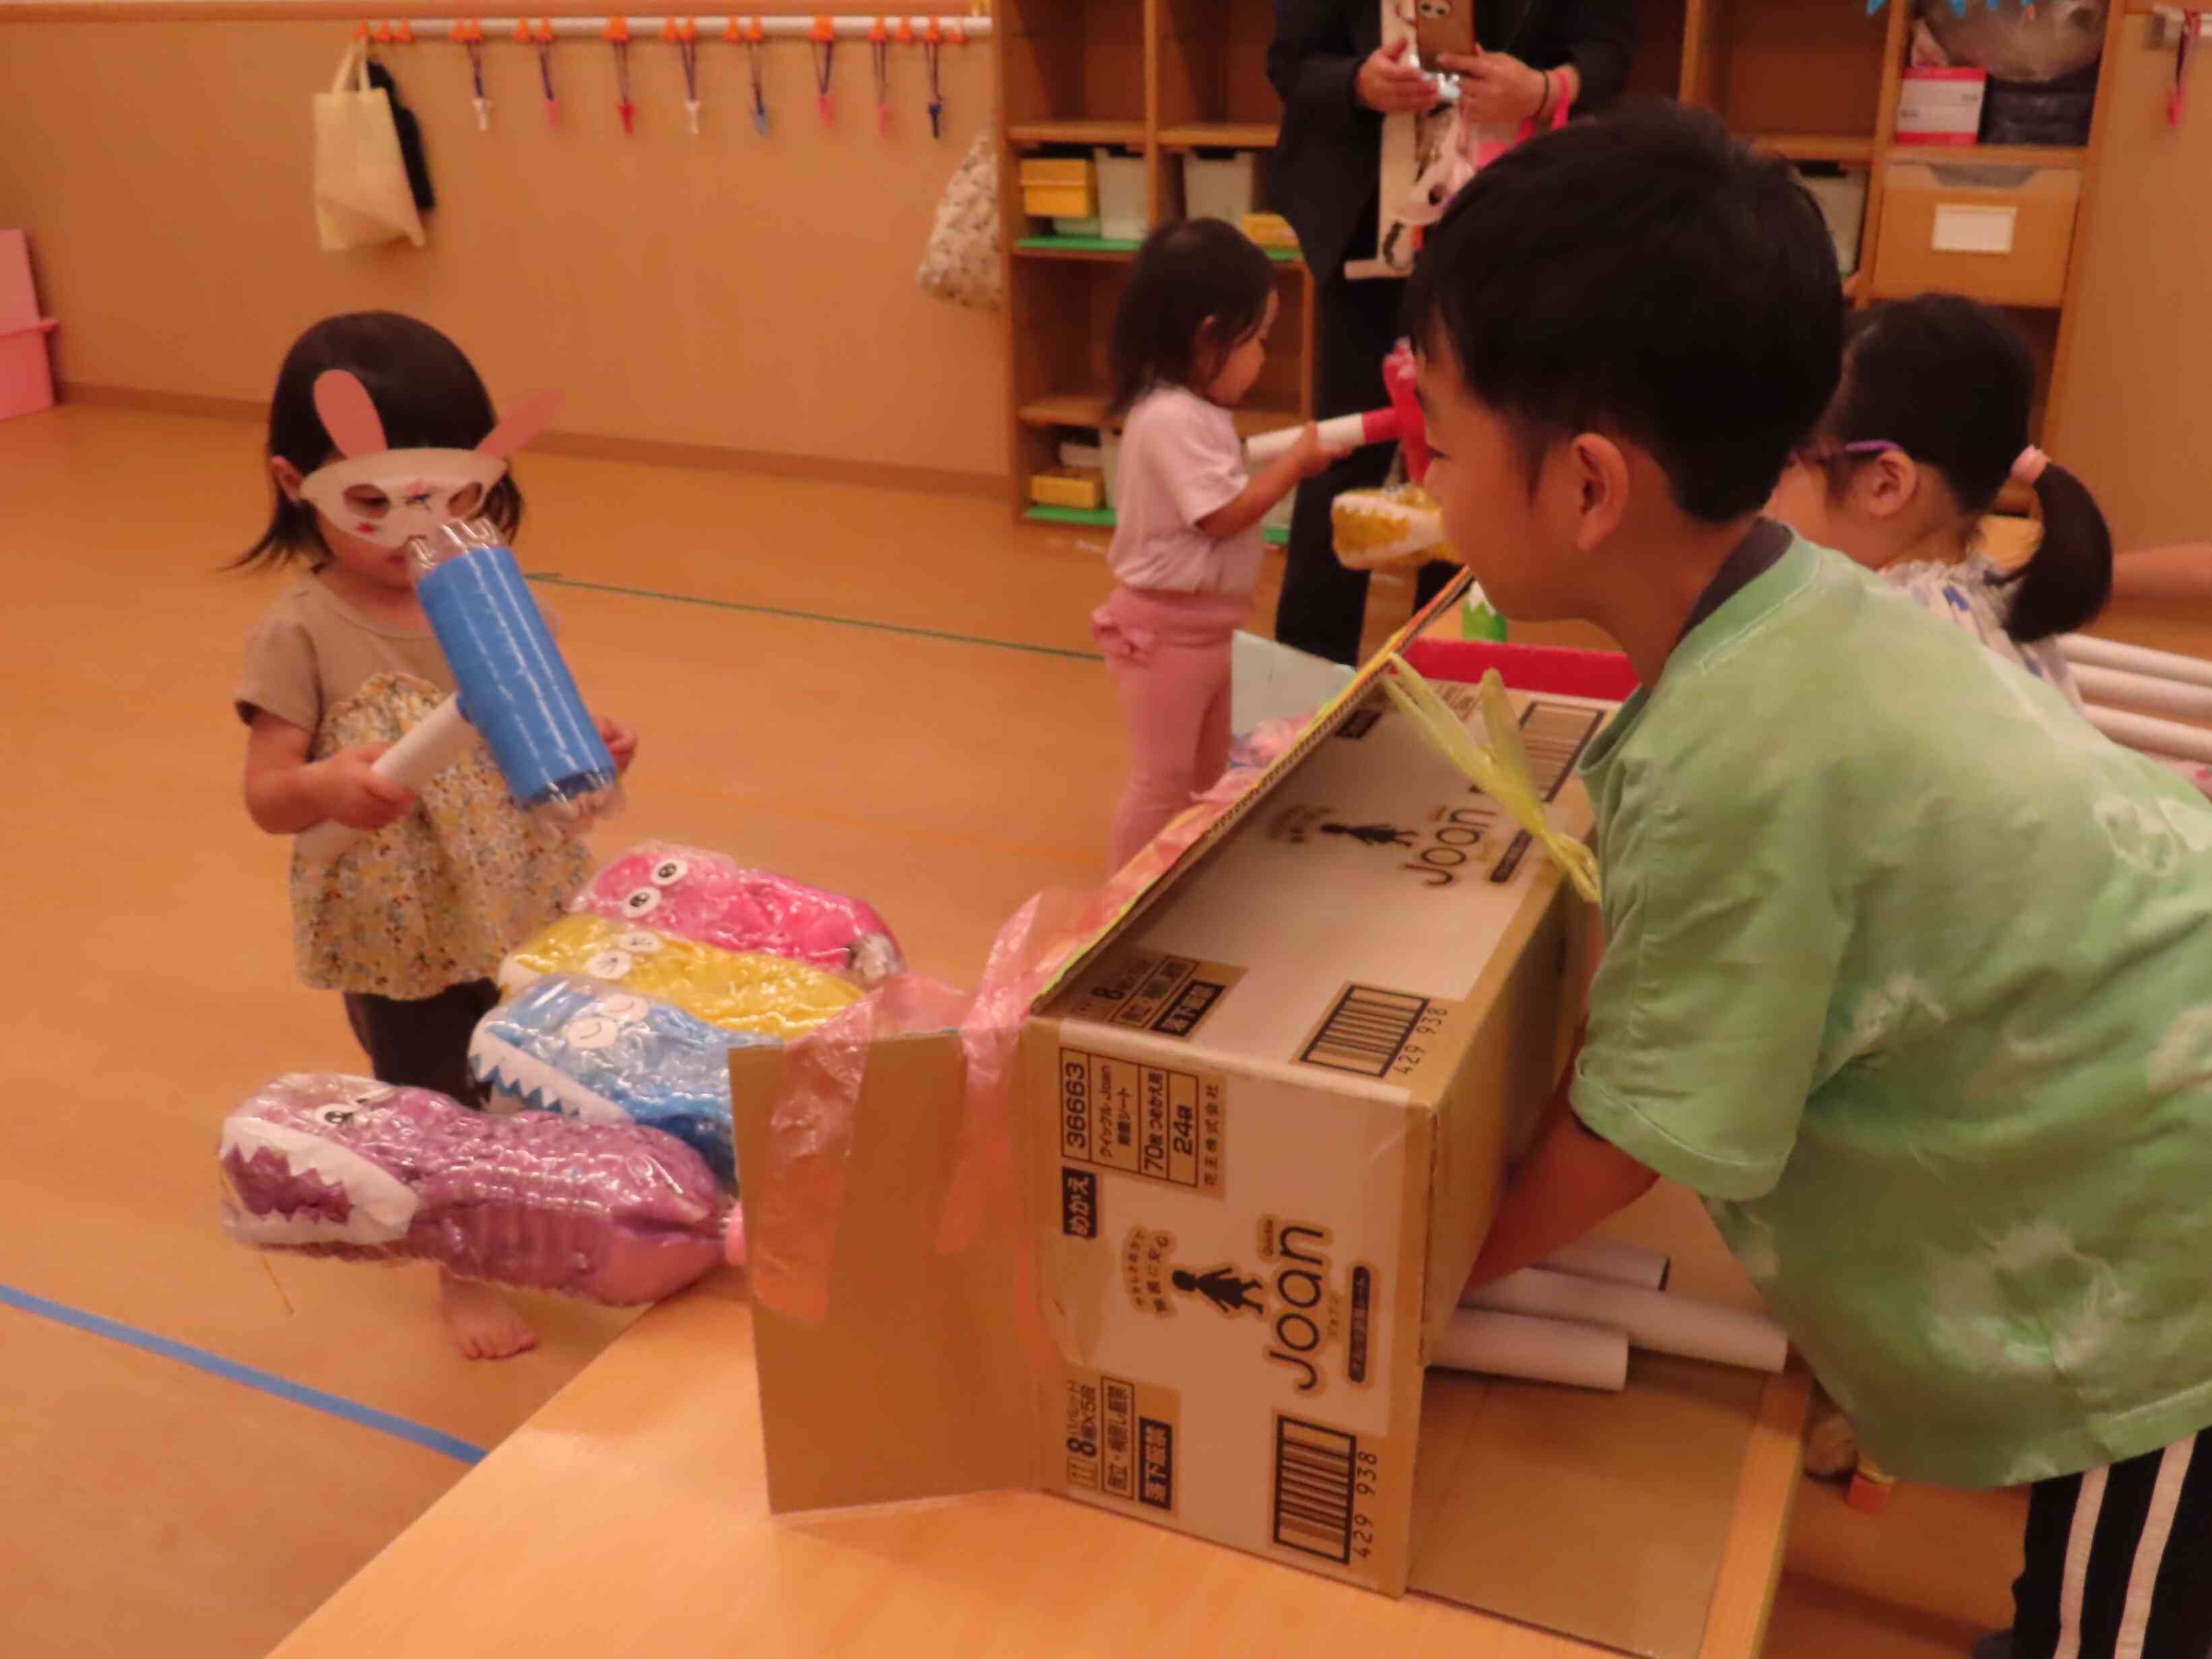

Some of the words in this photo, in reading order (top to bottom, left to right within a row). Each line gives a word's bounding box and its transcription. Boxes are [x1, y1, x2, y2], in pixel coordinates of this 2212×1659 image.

[1402, 808, 1497, 886] Joan
[1394, 1045, 1425, 1074] 429
[1417, 1007, 1447, 1035] 938
[1066, 1062, 1086, 1149] 36663
[1269, 1226, 1324, 1390] Joan
[1356, 1450, 1377, 1496] 938
[1353, 1514, 1374, 1559] 429
